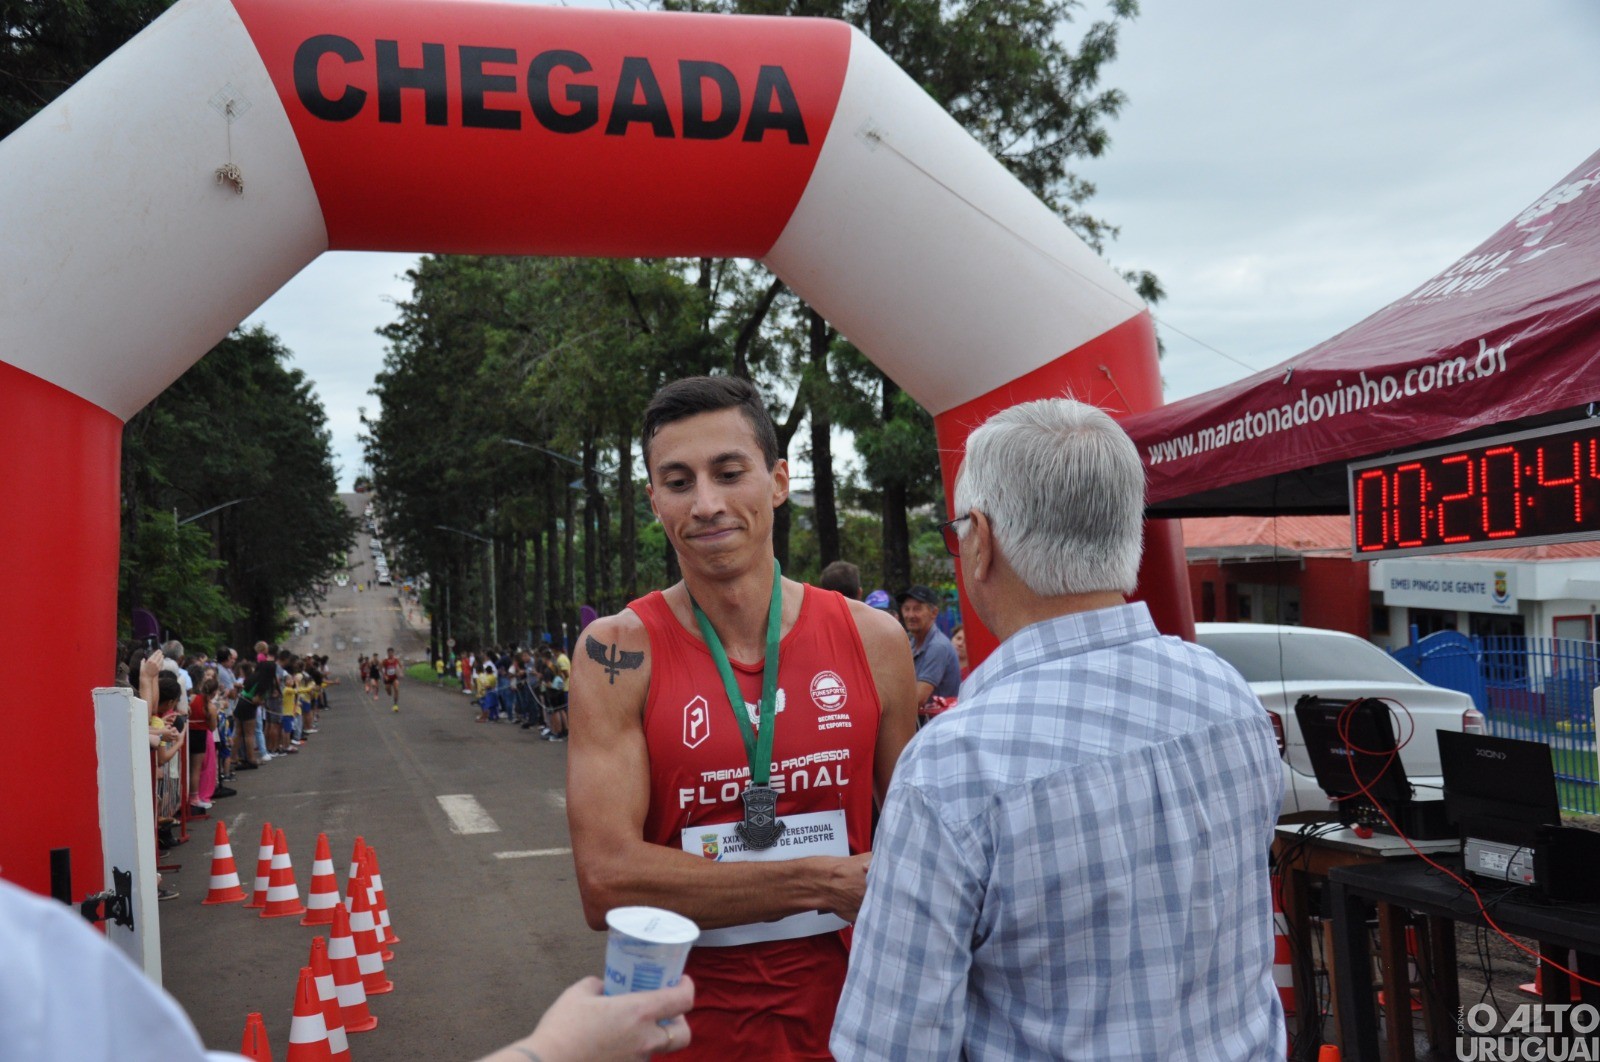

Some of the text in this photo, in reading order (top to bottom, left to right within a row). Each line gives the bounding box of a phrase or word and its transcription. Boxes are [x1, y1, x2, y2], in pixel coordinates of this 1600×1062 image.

[293, 33, 810, 146] CHEGADA
[1148, 338, 1512, 466] www.maratonadovinho.com.br
[1390, 578, 1487, 595] EMEI PINGO DE GENTE
[817, 713, 850, 723] SECRETARIA
[826, 721, 852, 730] ESPORTES
[701, 749, 850, 783] TREINAMO PROFESSOR
[722, 835, 740, 844] XXIX
[780, 838, 791, 847] DE
[793, 832, 835, 845] ALPESTRE
